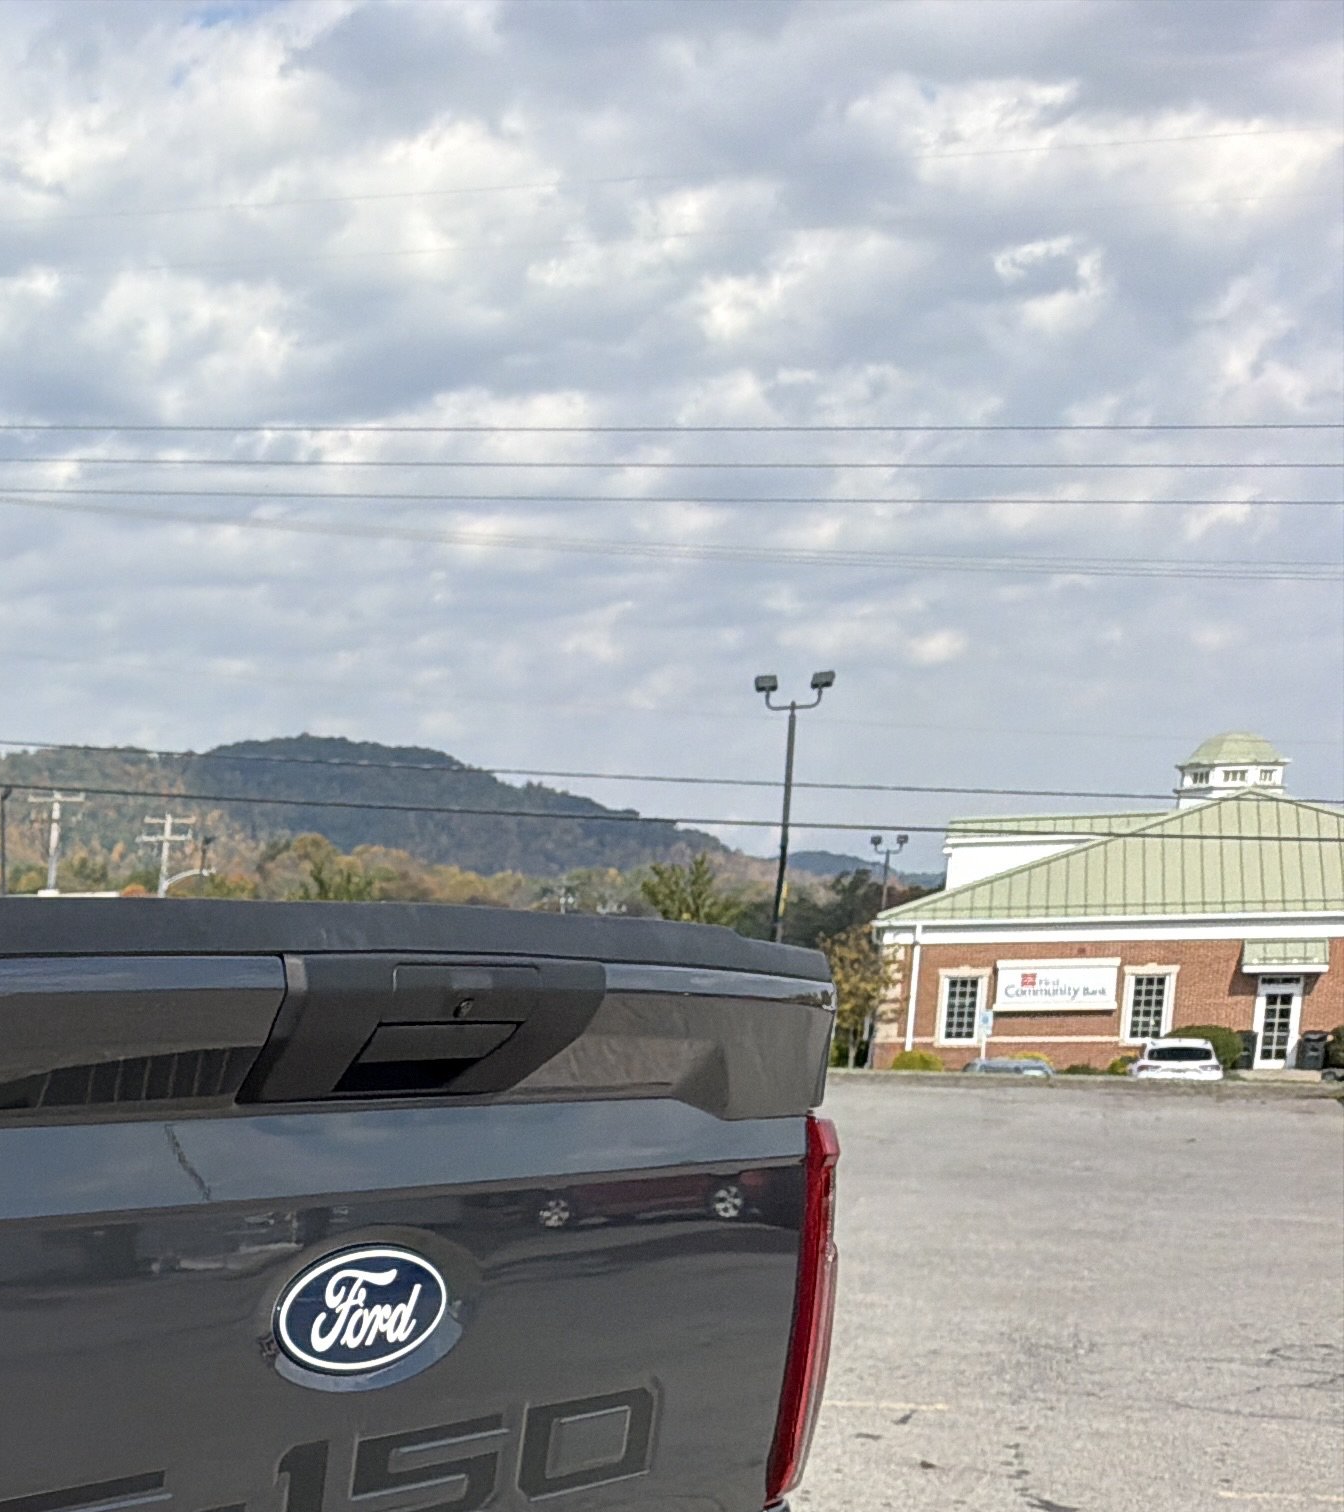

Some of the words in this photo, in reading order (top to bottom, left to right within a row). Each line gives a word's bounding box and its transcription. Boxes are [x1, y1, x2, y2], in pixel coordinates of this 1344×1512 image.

[1004, 985, 1080, 1000] Community
[1082, 986, 1107, 996] Bank
[311, 1268, 422, 1353] Ford
